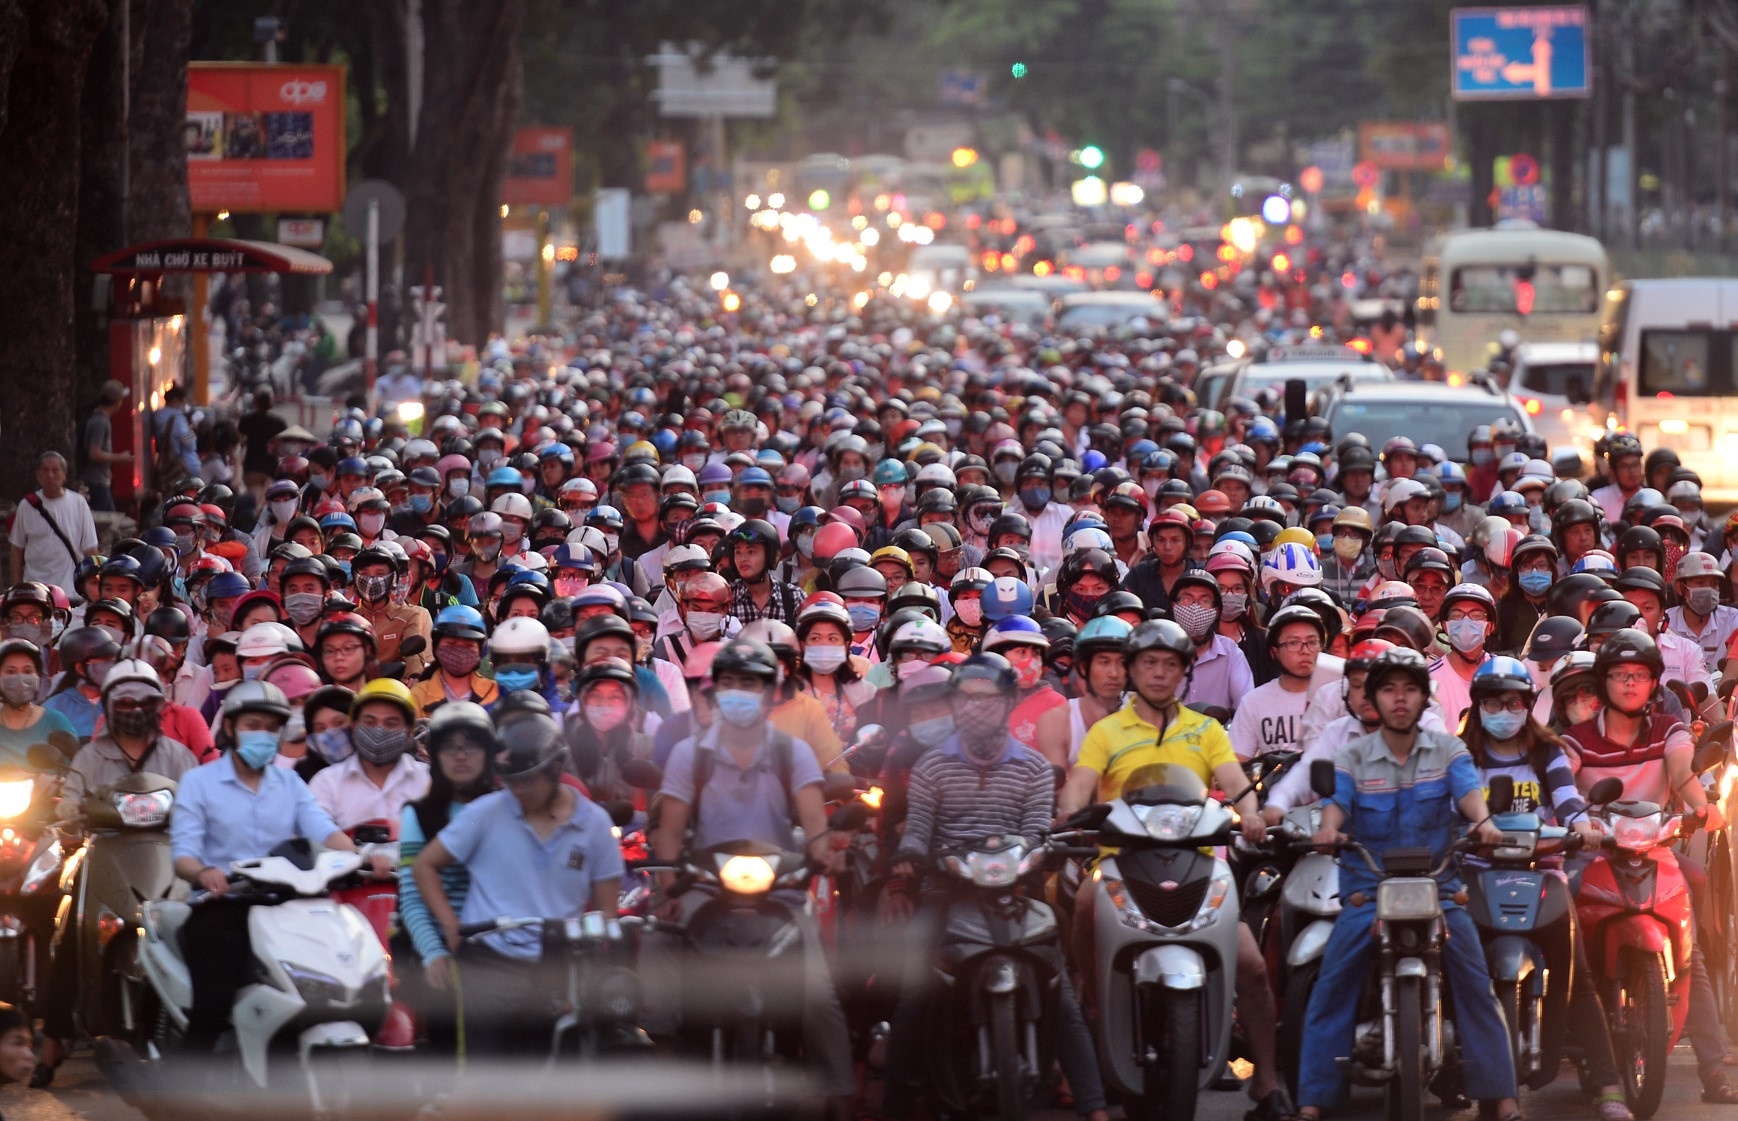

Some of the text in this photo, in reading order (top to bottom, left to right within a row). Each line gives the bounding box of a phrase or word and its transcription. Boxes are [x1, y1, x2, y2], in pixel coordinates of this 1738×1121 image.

[135, 250, 160, 267] NHÀ
[193, 252, 209, 267] XE
[1261, 714, 1303, 745] CAL
